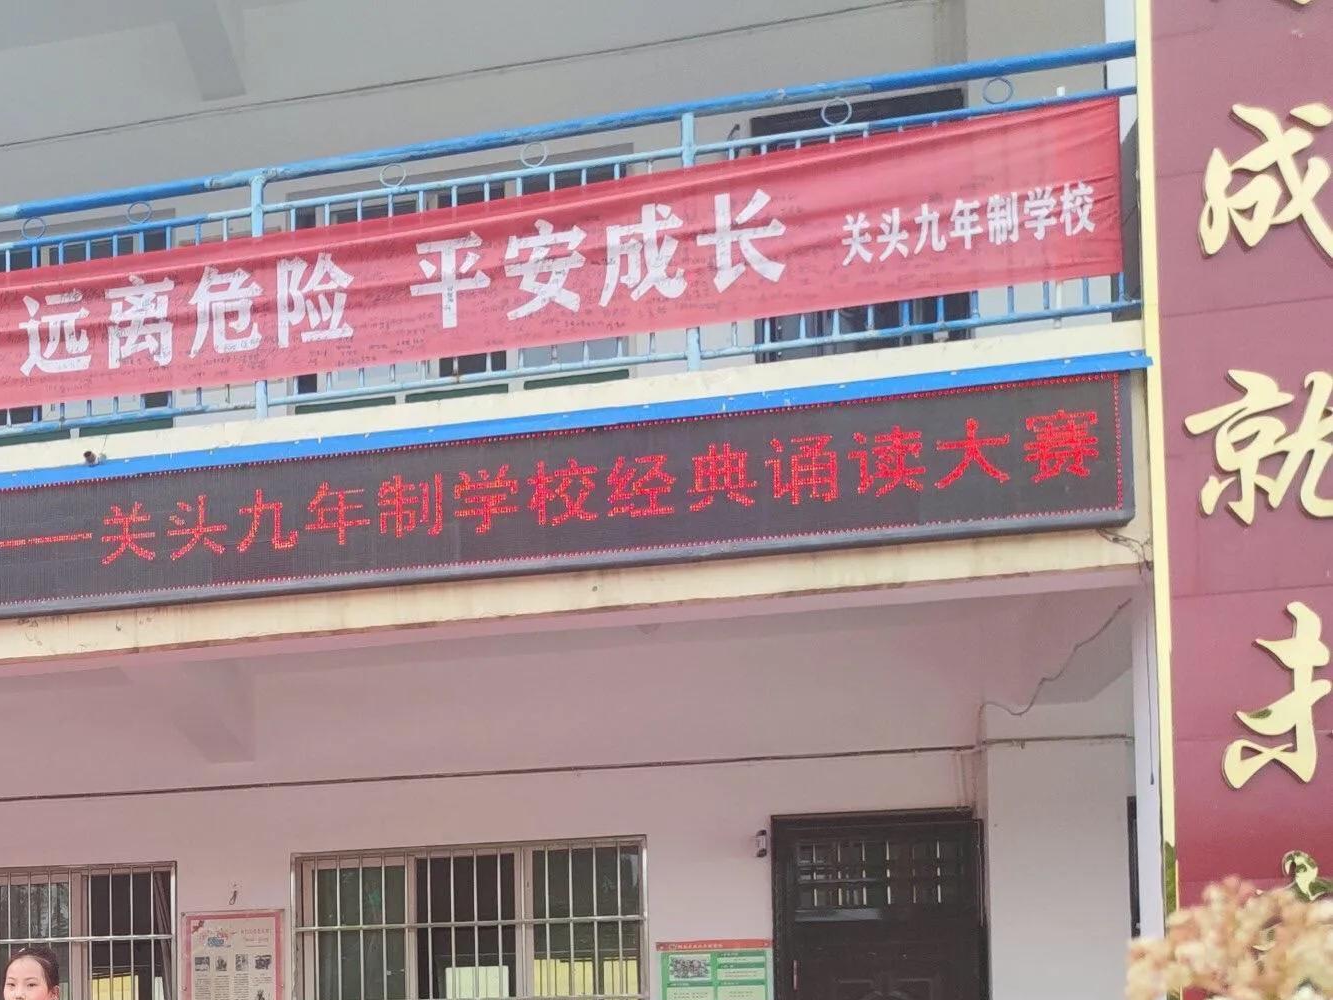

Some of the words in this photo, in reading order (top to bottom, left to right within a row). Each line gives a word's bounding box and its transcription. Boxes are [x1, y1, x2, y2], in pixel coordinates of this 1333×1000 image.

[19, 251, 355, 376] 远离危险
[409, 189, 786, 328] 平安成长
[841, 181, 1097, 266] 关头九年制学校
